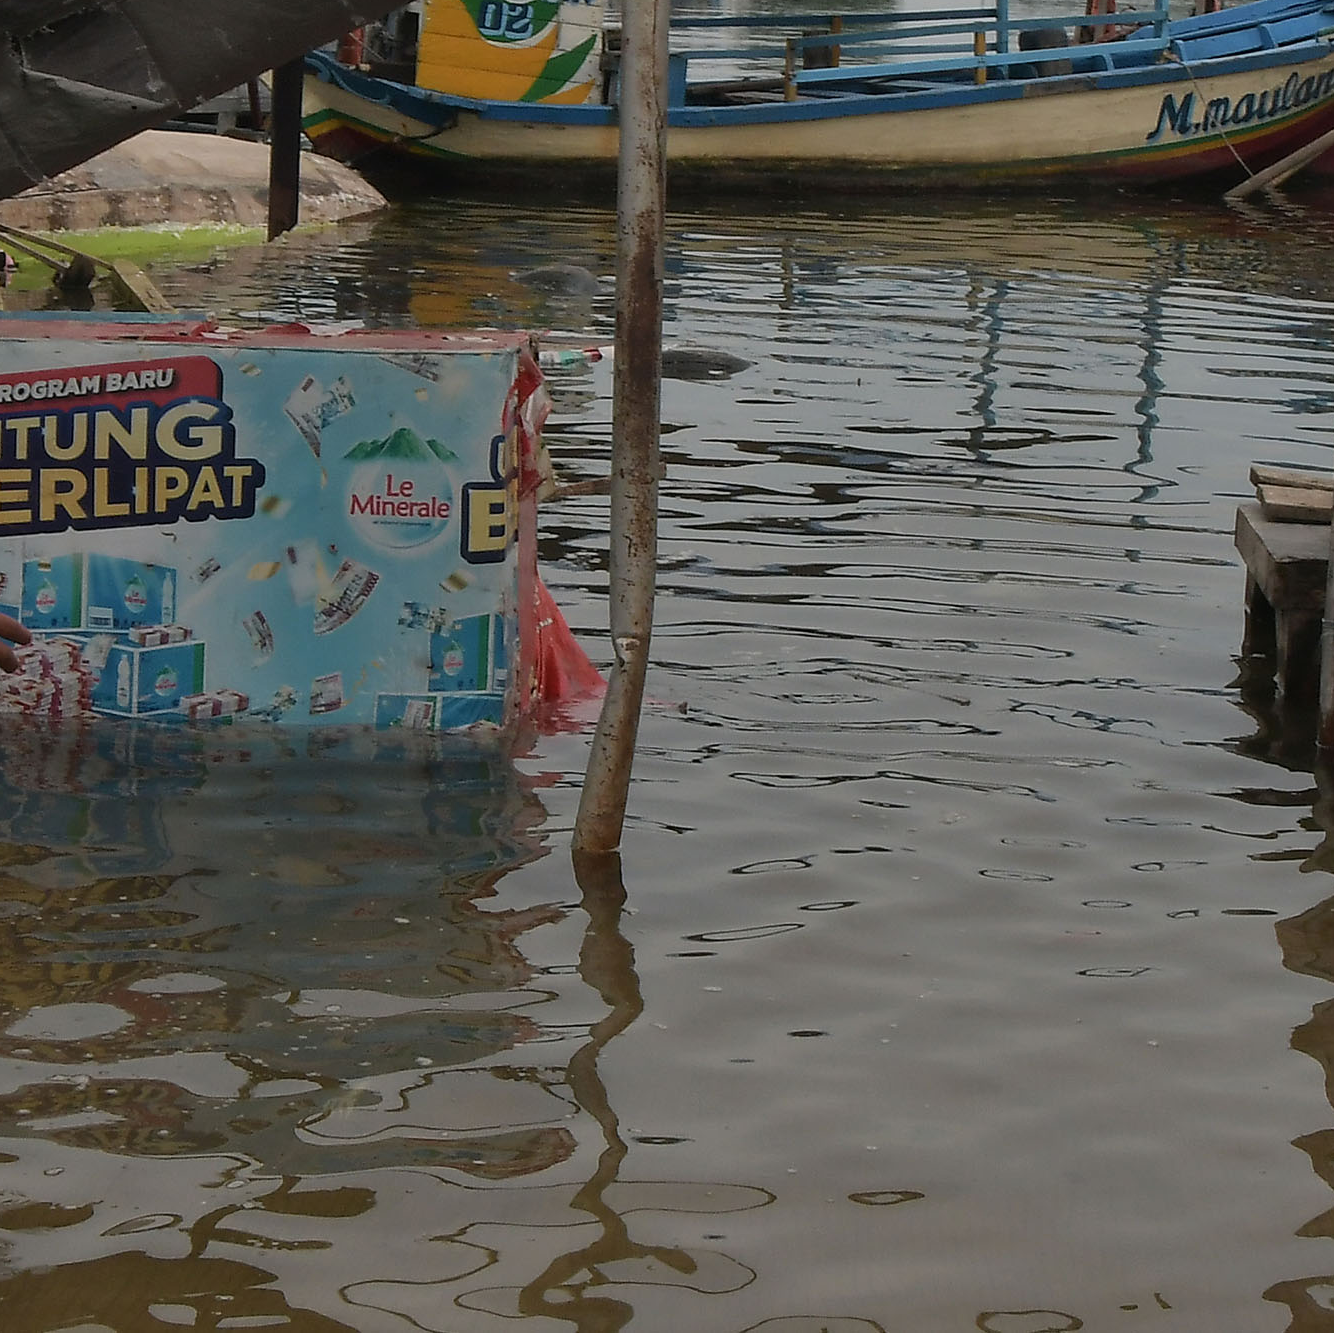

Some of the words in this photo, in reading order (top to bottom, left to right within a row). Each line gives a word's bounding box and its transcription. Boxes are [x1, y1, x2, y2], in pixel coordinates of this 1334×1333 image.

[105, 368, 174, 394] BARU
[386, 474, 414, 497] Le
[350, 494, 450, 518] Minerale
